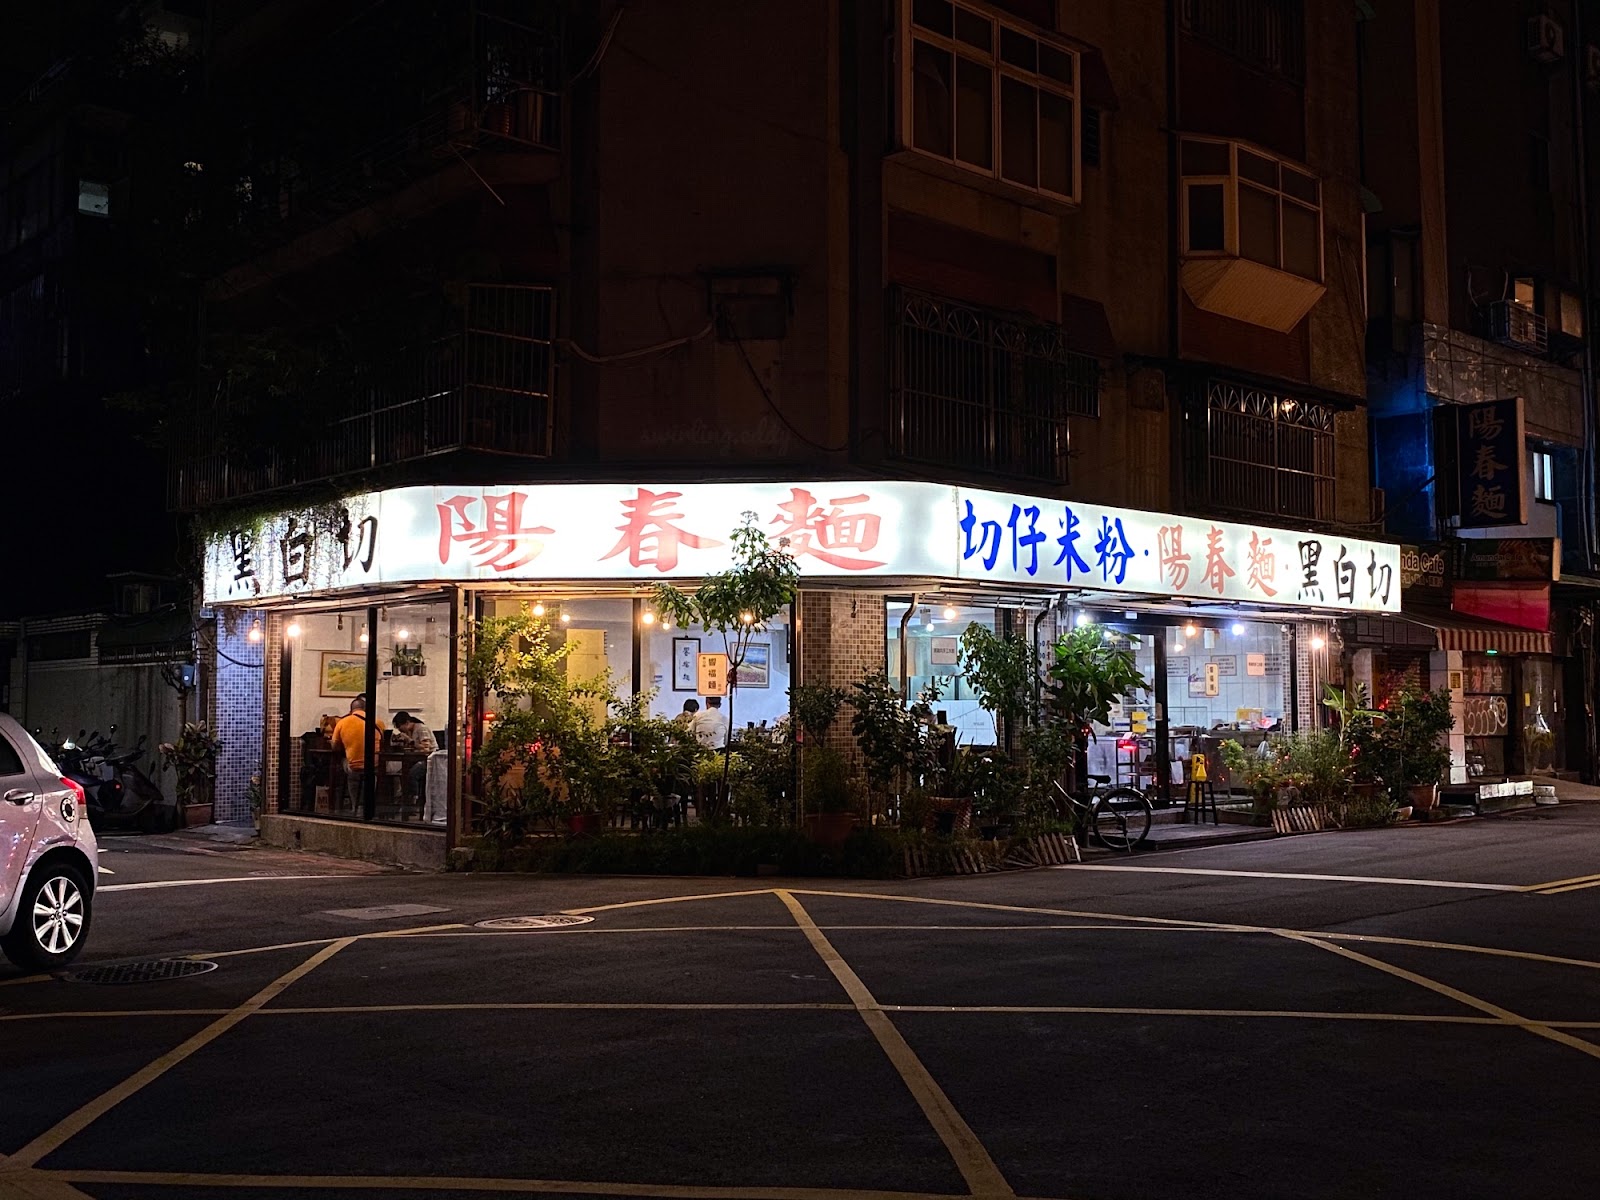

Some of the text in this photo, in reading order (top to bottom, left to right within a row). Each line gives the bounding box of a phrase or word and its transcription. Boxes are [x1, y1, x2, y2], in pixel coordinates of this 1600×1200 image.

[1468, 405, 1509, 519] 陽春麵
[436, 487, 889, 572] 陽春麵
[1420, 552, 1445, 575] Cafe
